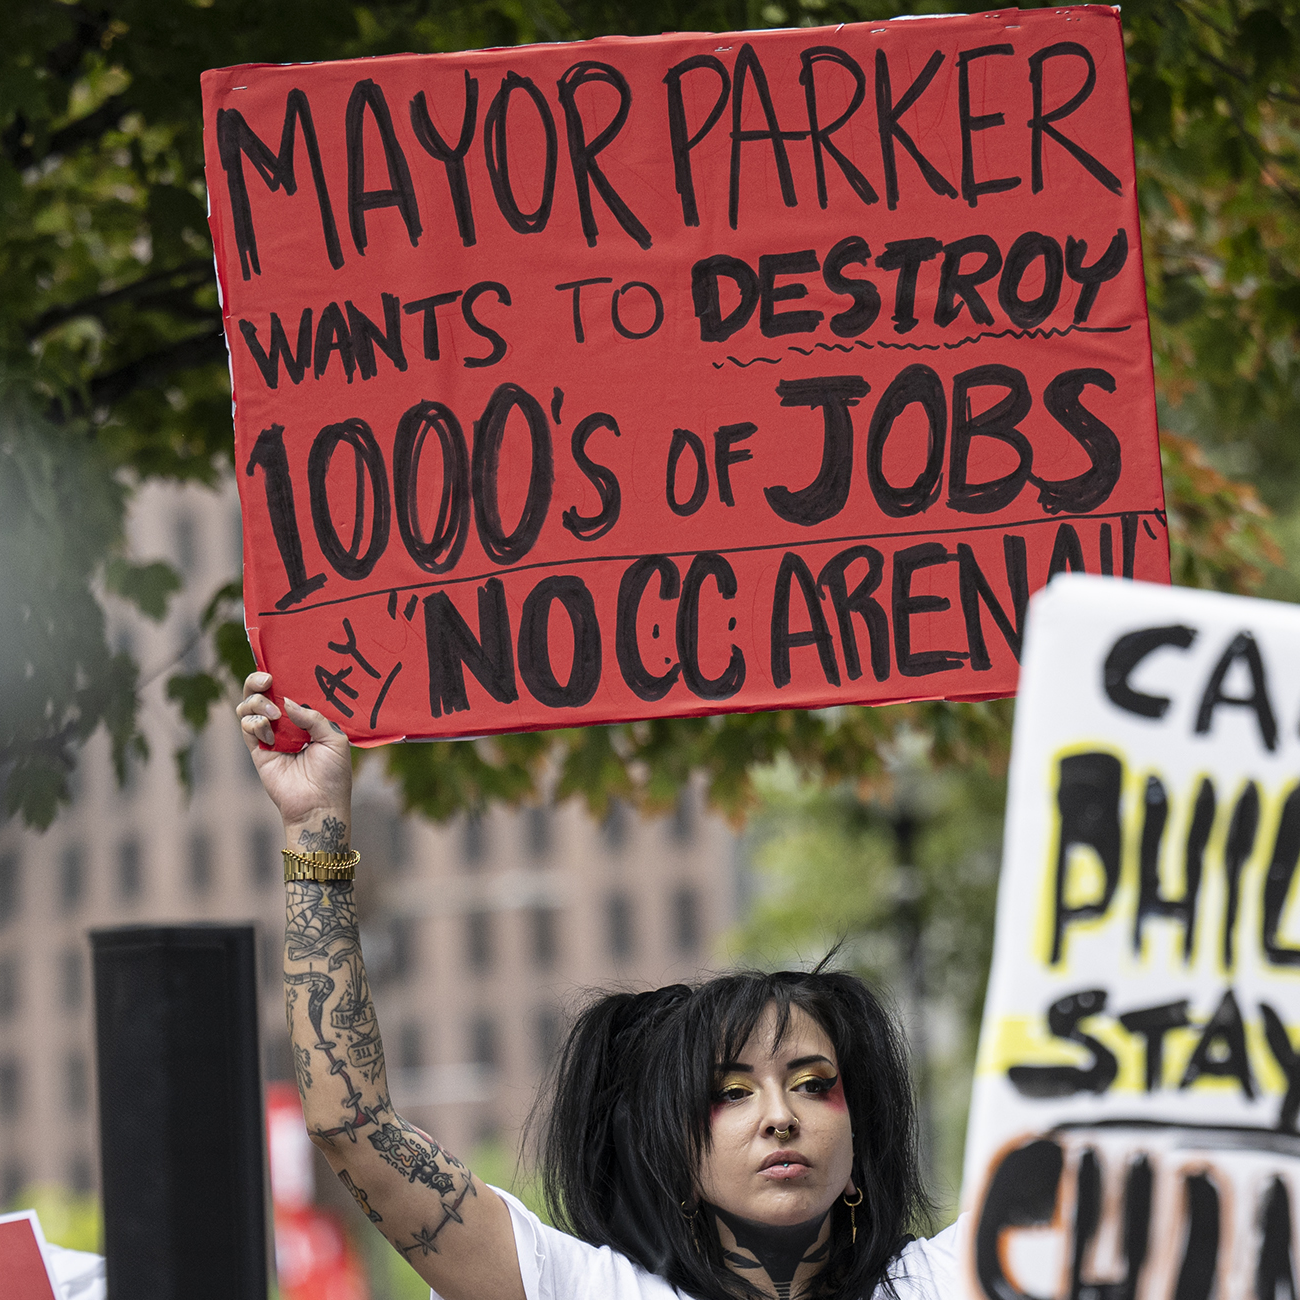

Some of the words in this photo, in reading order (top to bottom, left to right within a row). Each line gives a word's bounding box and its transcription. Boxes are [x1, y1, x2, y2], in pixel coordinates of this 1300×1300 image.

[217, 62, 652, 279] MAYOR
[664, 41, 1122, 229] PARKER
[240, 280, 511, 389] WANTS
[556, 276, 664, 343] TO
[694, 229, 1127, 343] DESTROY
[246, 382, 621, 612] 1000'S
[666, 422, 758, 516] OF
[764, 365, 1122, 526] JOBS
[409, 1138, 431, 1160] GOOD
